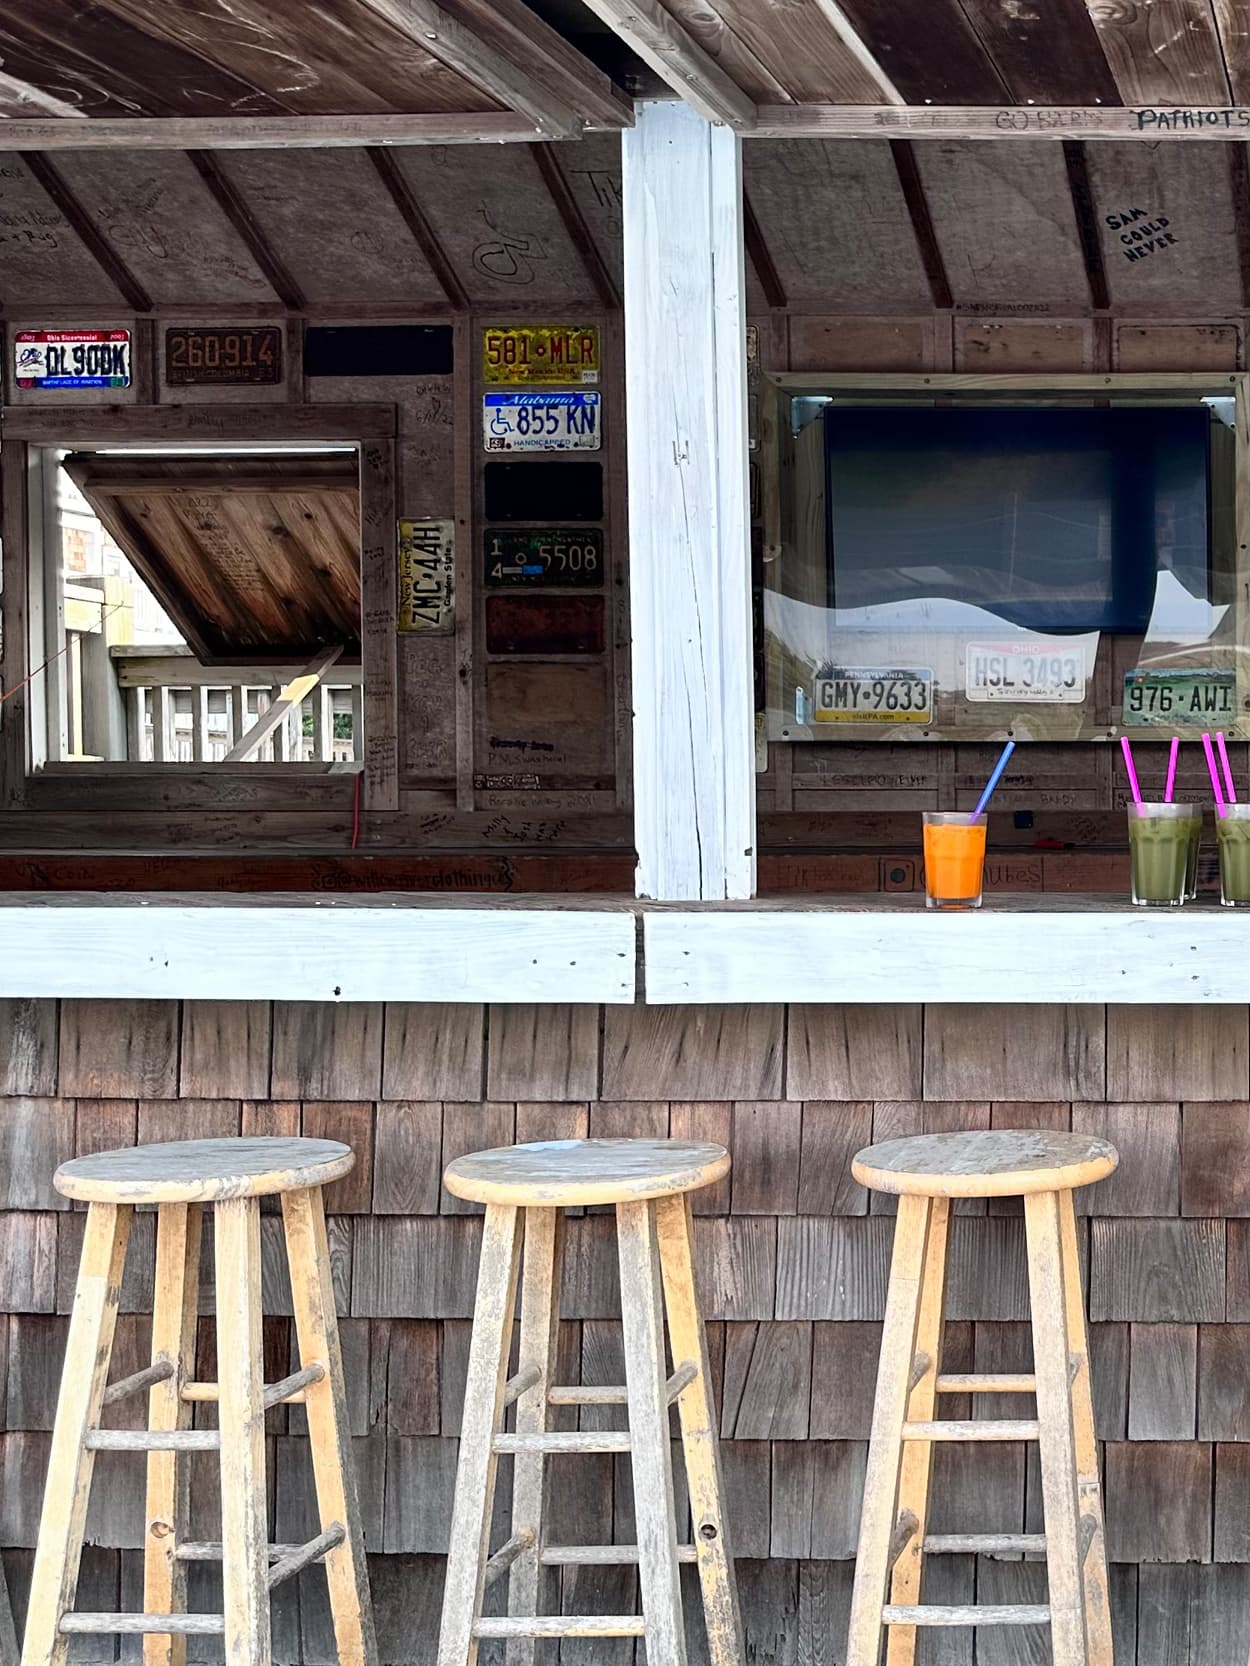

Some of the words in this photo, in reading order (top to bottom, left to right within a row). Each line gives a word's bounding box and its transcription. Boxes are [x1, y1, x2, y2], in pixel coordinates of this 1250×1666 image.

[1136, 110, 1250, 131] PATRIOTS
[1105, 208, 1148, 231] SAM
[1120, 217, 1170, 246] COULD
[1123, 232, 1179, 263] NEVER
[488, 336, 532, 365] 581
[550, 335, 594, 365] MLR
[517, 405, 560, 436] 855
[566, 405, 596, 435] KN
[513, 438, 572, 447] HANDICAPPED
[538, 545, 598, 572] 5508
[1010, 645, 1041, 654] OHIO
[844, 670, 904, 680] PENNSYLVANIA
[975, 656, 1015, 687] HSL
[1022, 656, 1076, 688] 3493
[820, 680, 861, 711] GMY
[872, 680, 928, 711] 9633
[1129, 686, 1173, 712] 976
[1189, 685, 1232, 712] AWI
